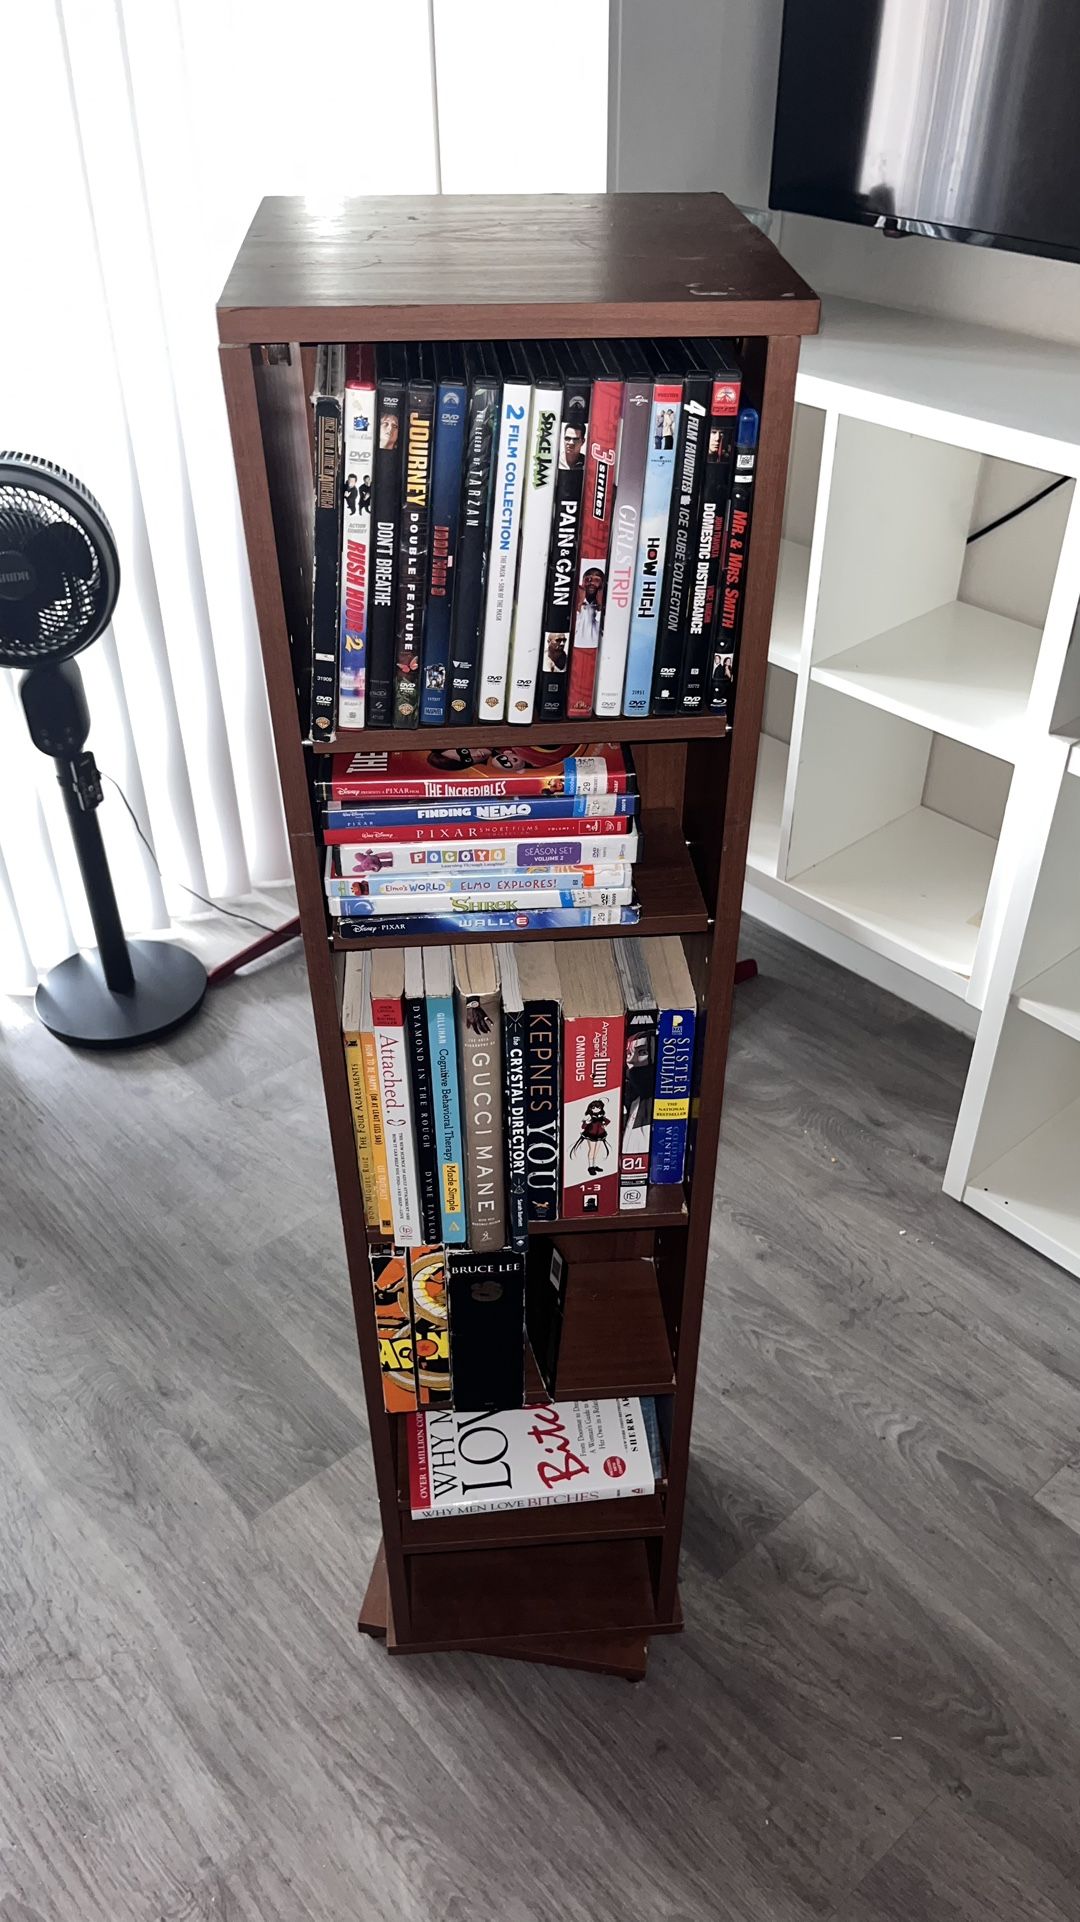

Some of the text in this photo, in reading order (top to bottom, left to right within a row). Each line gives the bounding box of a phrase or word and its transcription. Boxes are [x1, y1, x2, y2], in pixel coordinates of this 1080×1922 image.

[350, 451, 371, 459] DVD
[406, 412, 430, 507] JOURNEY
[473, 427, 483, 455] LEGEND
[473, 457, 481, 465] OF
[535, 412, 556, 487] SPACE JAM
[591, 443, 615, 466] 3
[318, 474, 335, 509] AMERICA
[466, 470, 483, 527] TARZAN
[500, 404, 525, 550] 2 FILM COLLECTION
[668, 400, 706, 632] 4 FILM FAVORITES ICE CUBE COLLECTION
[374, 522, 394, 606] DON'T BREATHE
[432, 526, 449, 557] IRON
[552, 500, 578, 606] PAIN & GAIN
[611, 504, 636, 609] GIRLS TRIP
[404, 513, 419, 651] DOUBLE FEATURE
[431, 558, 447, 585] MAN
[638, 537, 660, 619] HOW HIGH
[690, 503, 717, 635] DOMESTIC DISTURBANCE
[721, 510, 748, 629] MR. & MRS. SMITH
[344, 539, 367, 652] RUSH HOUR 2
[336, 787, 361, 796] Disney
[424, 781, 443, 797] THE
[444, 780, 507, 797] INCREDIBLES
[417, 804, 532, 819] FINDING NEMO
[413, 850, 504, 864] POCOYO
[417, 827, 478, 839] PIXAR
[479, 825, 509, 833] SHORT
[524, 846, 573, 857] SEASON SET
[385, 878, 557, 892] Elmo's WORLD ELMO EXPLORES!
[451, 897, 519, 913] SHREK
[352, 924, 377, 933] Disney
[529, 1014, 552, 1111] KEPNES
[575, 1035, 586, 1082] OMNIBUS
[592, 1031, 602, 1057] Agent
[600, 1020, 610, 1057] Amazing
[351, 1063, 364, 1113] AGREEMENTS
[380, 1033, 405, 1114] Attached.
[412, 1005, 431, 1148] DYAMOND IN THE ROUGH
[660, 1037, 677, 1095] SOULJAH
[673, 1037, 691, 1094] SISTER
[438, 1048, 454, 1162] Cognitive Behavioral Therapy
[472, 1052, 492, 1135] GUCCI
[510, 1036, 525, 1175] the CRYSTAL DIRECTORY
[357, 1115, 366, 1134] FOUR
[358, 1136, 367, 1149] THE
[663, 1126, 673, 1171] WINTER
[476, 1145, 495, 1213] MANE
[526, 1119, 557, 1192] YOU
[622, 1157, 646, 1170] 01
[425, 1171, 437, 1240] DYME TAYLOR
[445, 1164, 457, 1211] Made Simple
[451, 1262, 521, 1274] BRUCE LEE
[625, 1413, 638, 1453] SHERRY
[417, 1429, 428, 1499] OVER MILLION
[430, 1434, 459, 1500] WHY
[422, 1490, 600, 1518] WHY MEN LOVE BITCHES
